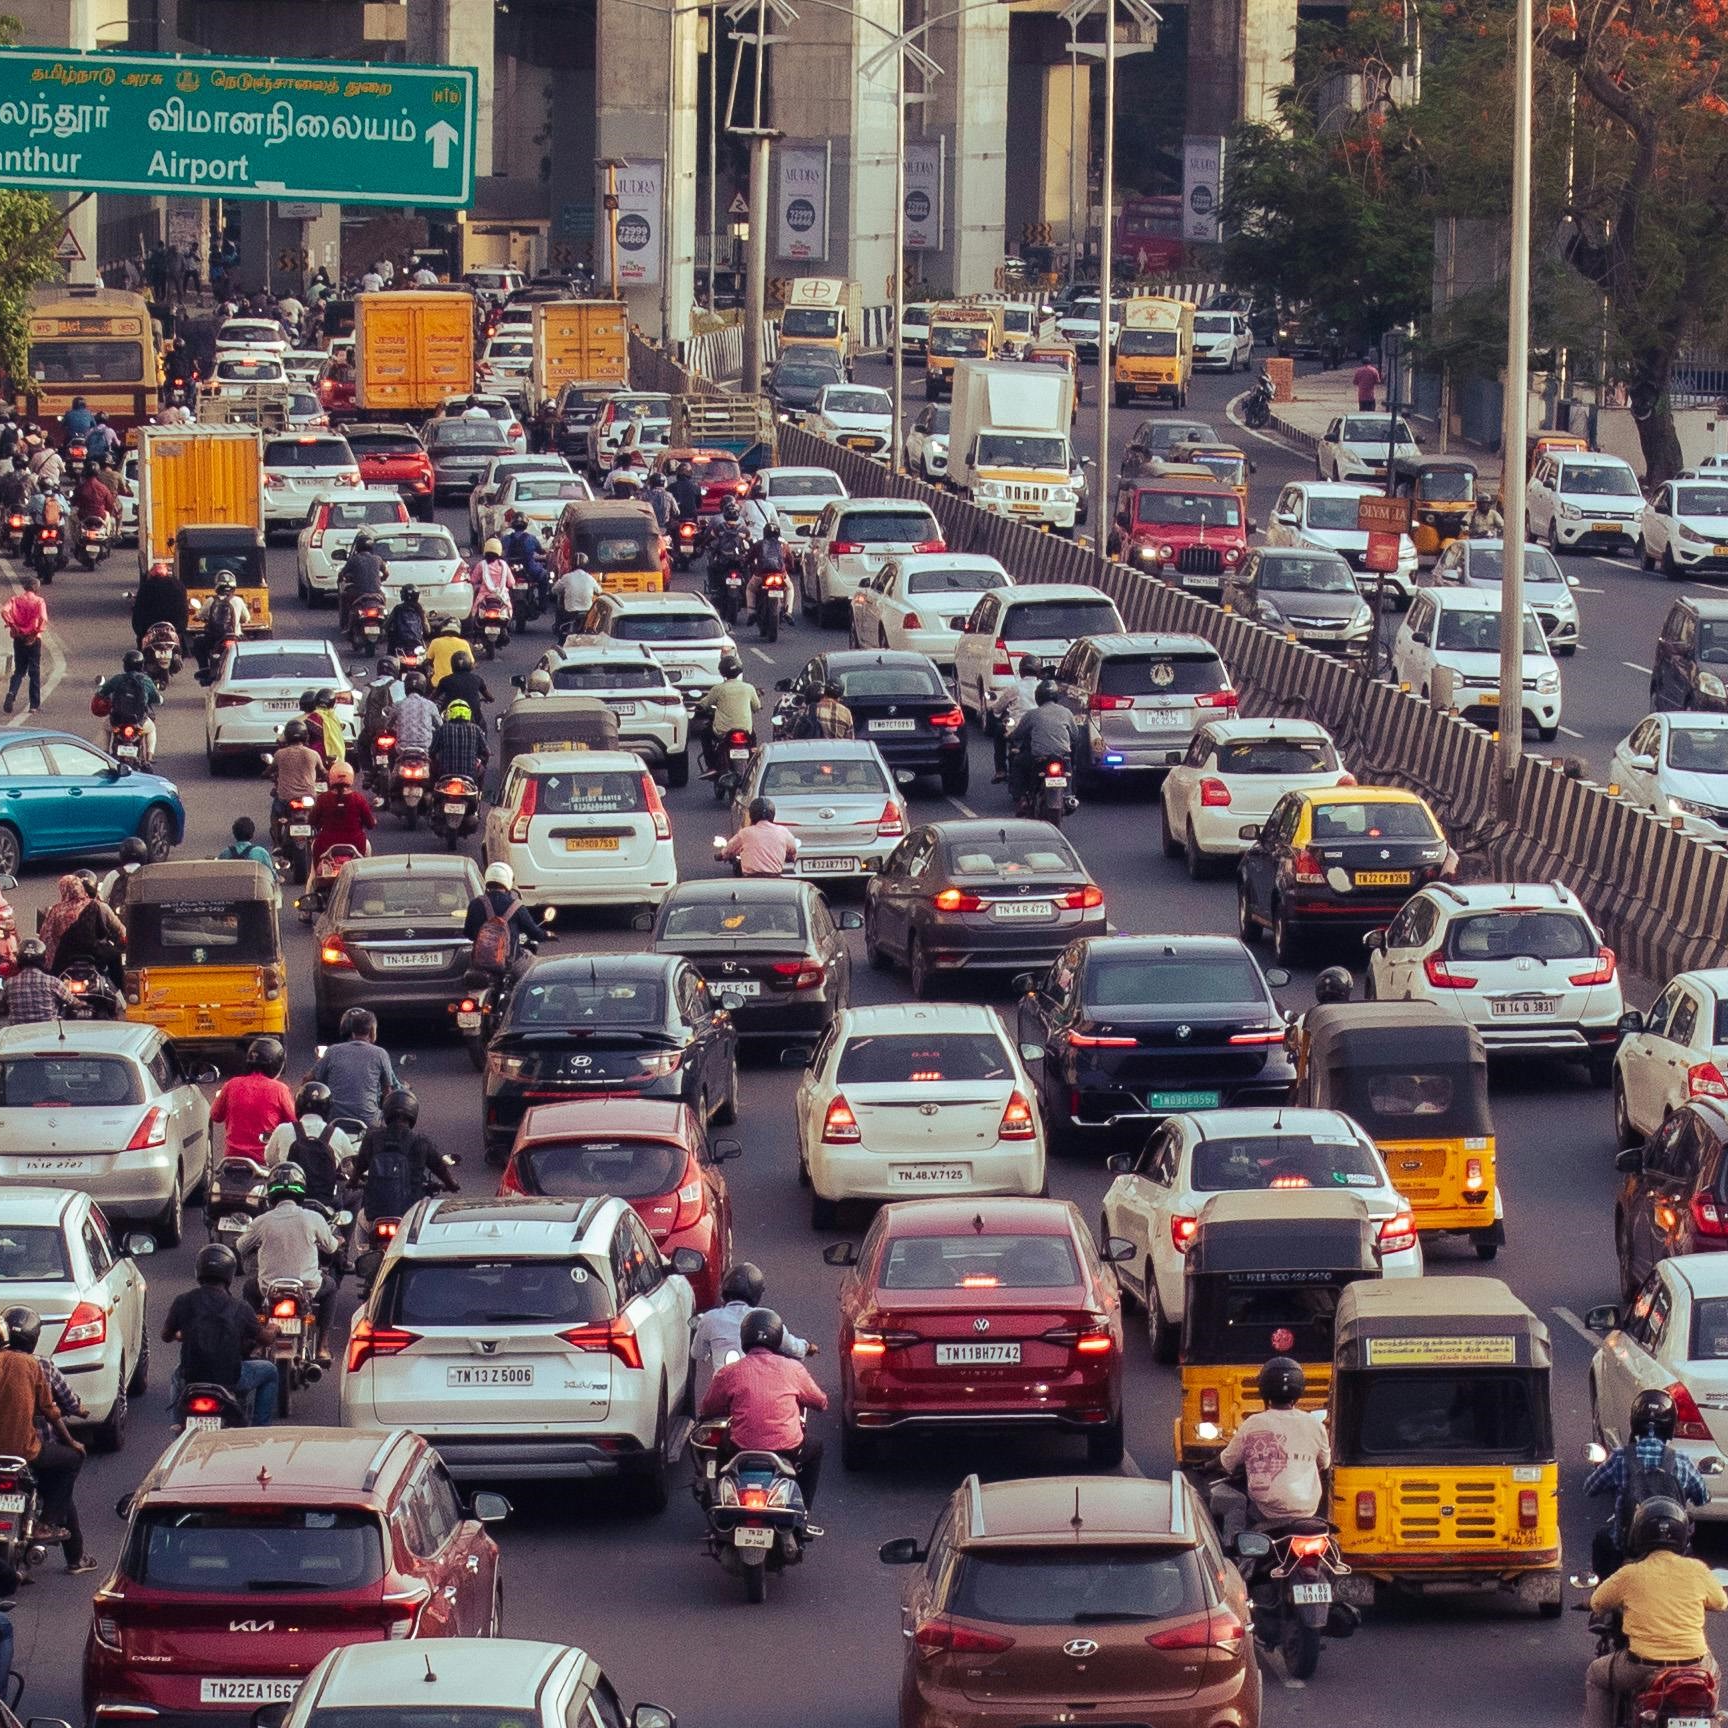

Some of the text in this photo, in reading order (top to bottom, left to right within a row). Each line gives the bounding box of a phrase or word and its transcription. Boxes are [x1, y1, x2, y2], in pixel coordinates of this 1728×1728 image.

[31, 63, 164, 87] தமிழ்நாடு அரசு
[148, 95, 416, 147] விமானநிலையம்
[147, 150, 249, 184] Airport
[618, 225, 648, 234] 72999
[618, 234, 647, 243] 66666
[898, 1170, 963, 1181] TN.48.V.7125
[945, 1346, 1019, 1361] TN11BH7742
[456, 1370, 472, 1383] TN
[475, 1370, 489, 1383] 13
[500, 1370, 531, 1383] 5006
